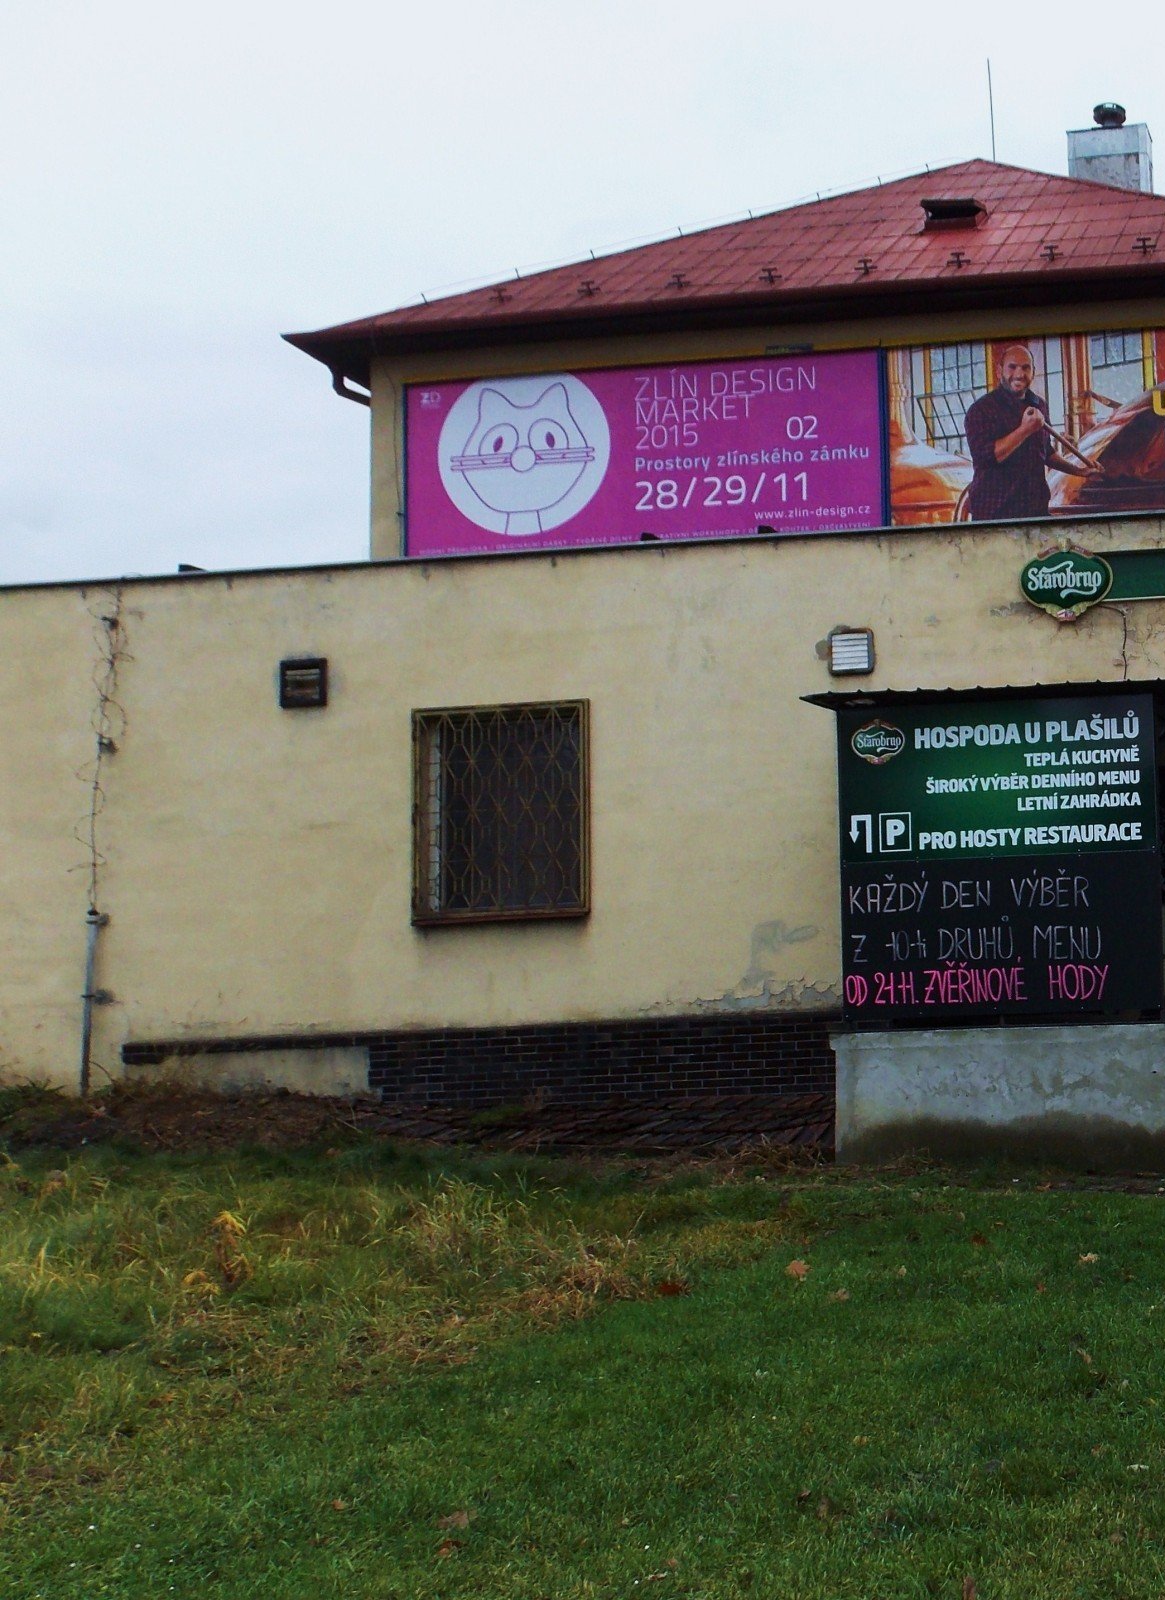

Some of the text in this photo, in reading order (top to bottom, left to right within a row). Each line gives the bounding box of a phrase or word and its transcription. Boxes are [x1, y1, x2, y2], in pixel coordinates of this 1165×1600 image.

[634, 366, 816, 401] ZLÍN DESIGN
[635, 394, 755, 425] MARKET
[635, 415, 818, 449] 2015 02
[635, 444, 869, 472] Prostory zlínského zámku
[635, 472, 808, 511] 28/29/11
[755, 505, 870, 520] www.zlin-design.cz
[1027, 560, 1102, 599] Starobrno
[857, 731, 901, 752] Starobrno
[914, 710, 1139, 749] HOSPODA U PLAŠILŮ
[1024, 745, 1139, 767] TEPLÁ KUCHYNĚ
[926, 769, 1140, 794] ŠIROKÝ VÝBĚR DENNÍHO MENU
[1017, 790, 1141, 811] LETNÍ ZAHRÁDKA
[919, 832, 956, 850] PRO
[960, 828, 1021, 848] HOSTY
[1024, 822, 1142, 845] RESTAURACE
[850, 869, 1089, 914] KAŽDÝ DEN VÝBĚR
[851, 935, 868, 962] Z
[937, 915, 1013, 960] DRUHŮ
[1033, 925, 1101, 960] MENU
[846, 975, 867, 1006] OD
[925, 956, 1028, 1005] ZVĚŘINOVÉ
[1048, 965, 1109, 1001] HODY
